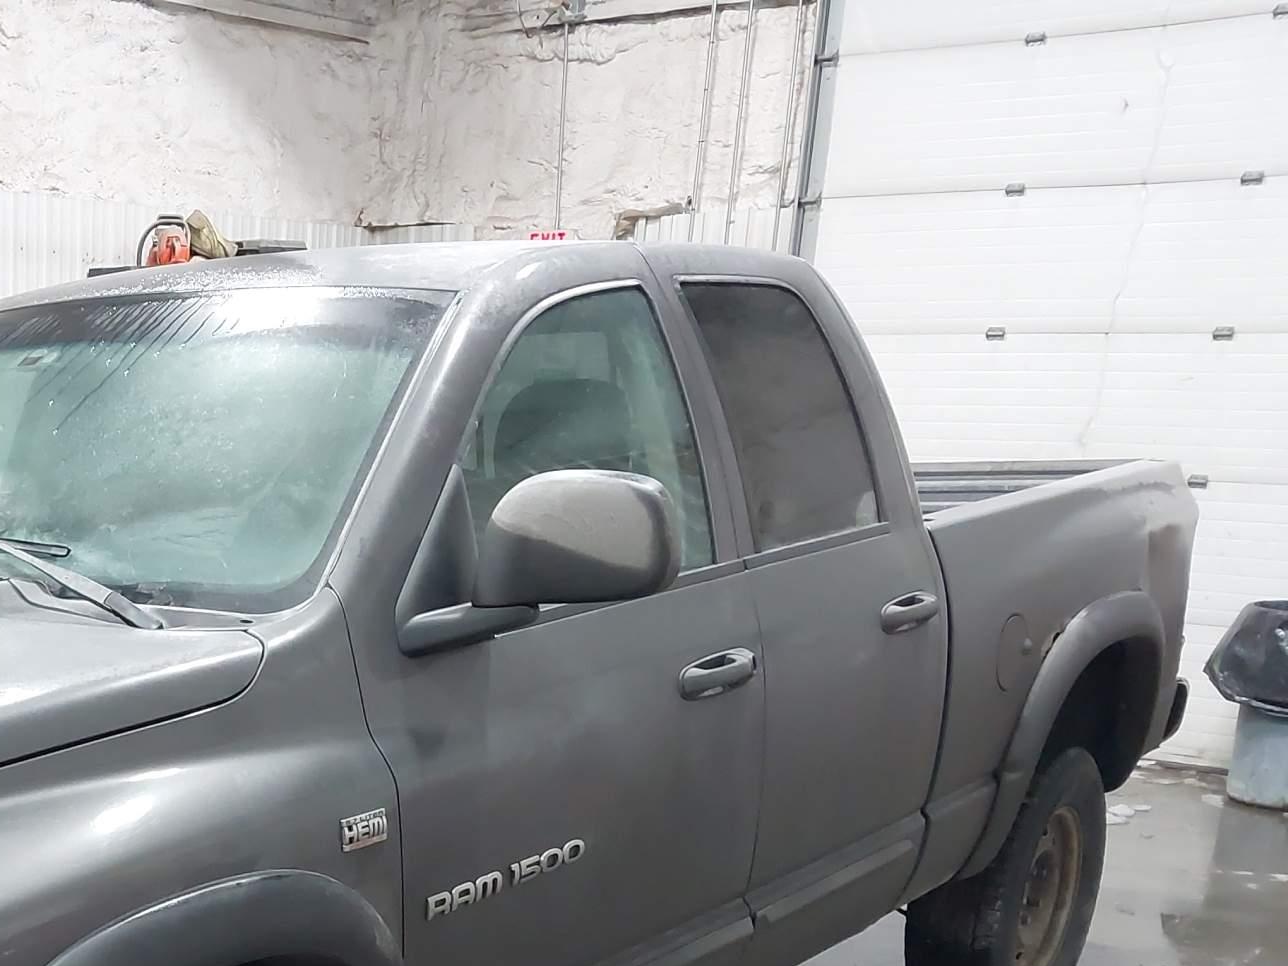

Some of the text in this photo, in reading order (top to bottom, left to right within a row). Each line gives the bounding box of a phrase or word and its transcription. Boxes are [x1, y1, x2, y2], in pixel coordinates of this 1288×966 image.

[343, 815, 387, 845] HEMI
[427, 839, 585, 921] RAM 1500
